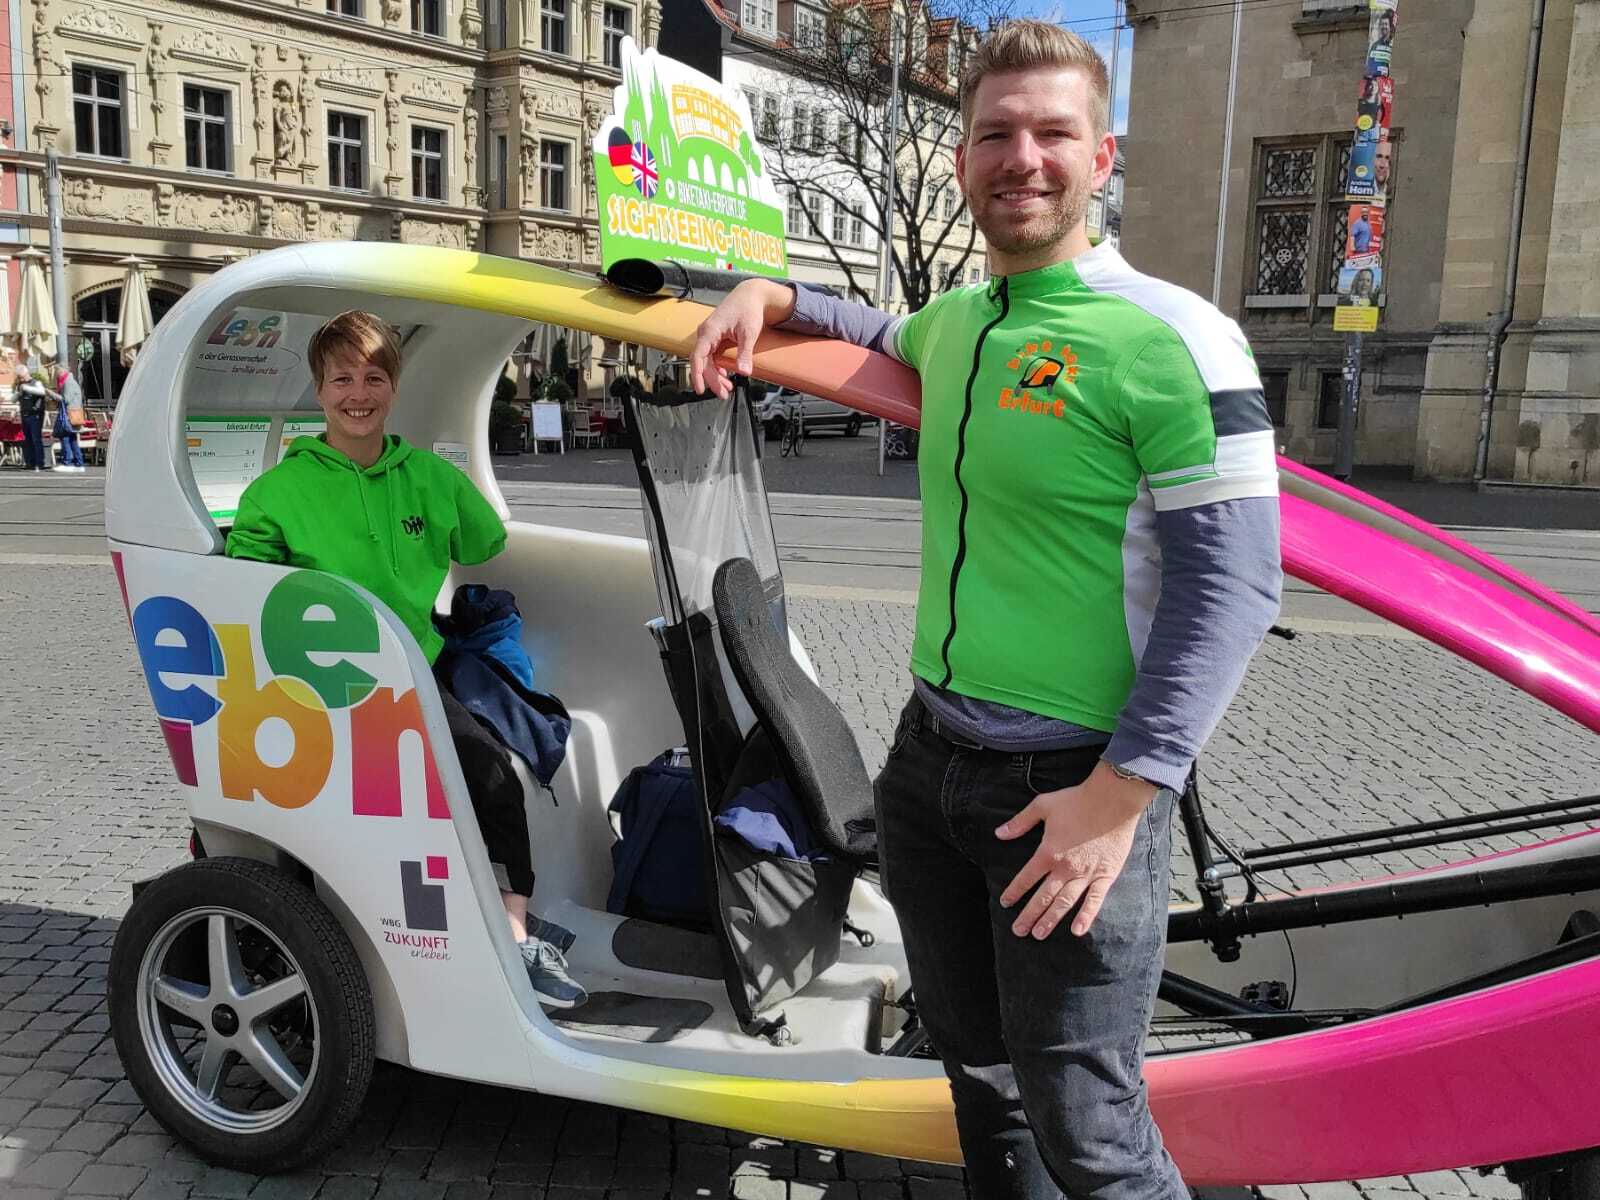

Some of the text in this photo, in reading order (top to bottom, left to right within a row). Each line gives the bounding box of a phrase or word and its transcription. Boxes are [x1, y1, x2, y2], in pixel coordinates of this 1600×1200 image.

[607, 194, 785, 270] SIGHTSEEING-TOUREN
[207, 310, 282, 349] Leben
[999, 387, 1065, 418] Erfurt
[379, 916, 401, 928] WBG
[383, 930, 449, 950] ZUKUNFT
